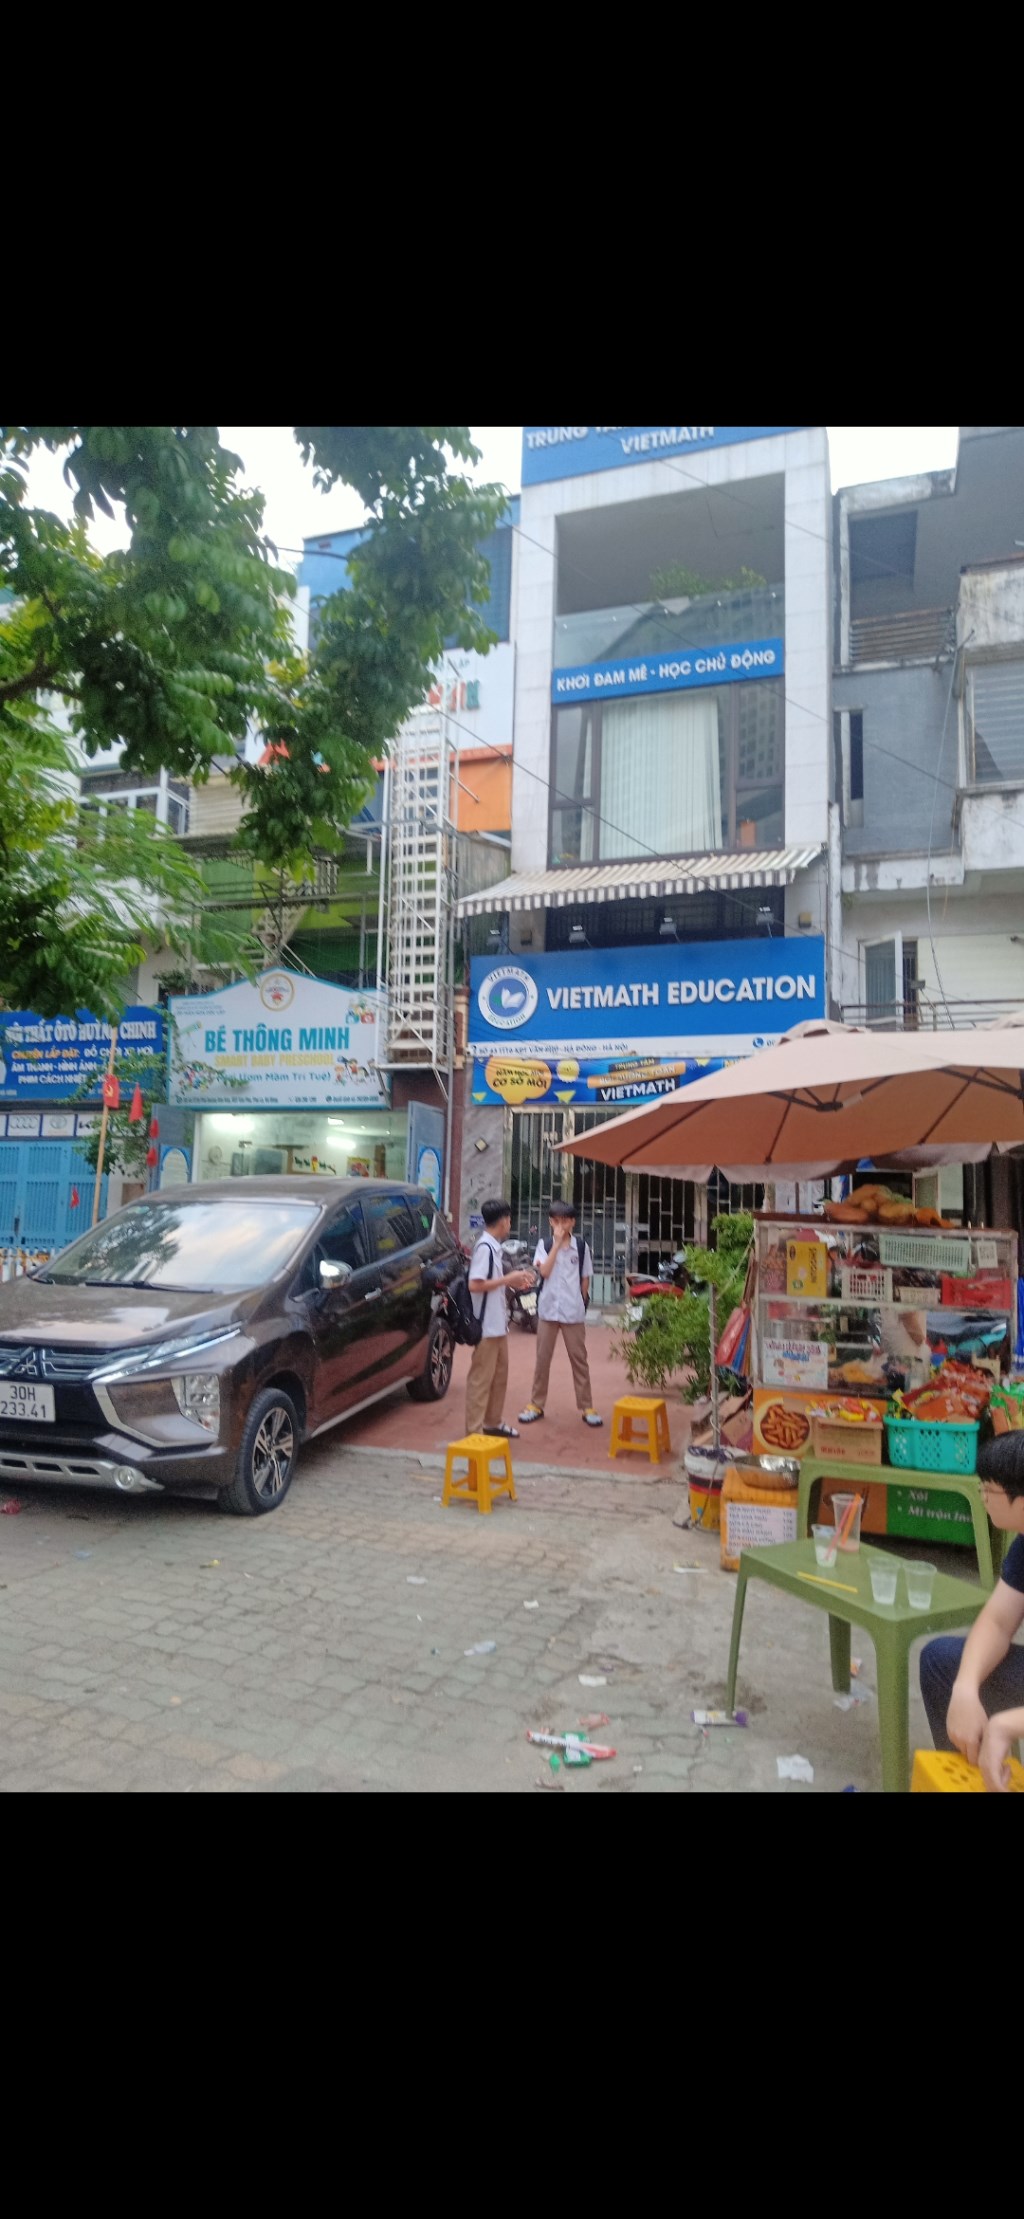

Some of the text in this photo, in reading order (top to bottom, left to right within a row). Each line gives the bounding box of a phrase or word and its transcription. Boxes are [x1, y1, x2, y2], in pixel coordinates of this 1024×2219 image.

[527, 427, 588, 449] TRUNG
[621, 427, 715, 454] VIETMATH
[594, 669, 625, 688] ĐAM
[629, 664, 648, 681] MÊ
[659, 662, 691, 679] HỌC
[695, 652, 725, 673] CHỦ
[731, 649, 775, 670] ĐỘNG
[546, 975, 816, 1009] VIETMATH EDUCATION
[205, 1022, 349, 1053] BÉ THÔNG MINH
[600, 1078, 676, 1102] VIETMATH
[10, 1385, 36, 1401] 30H
[1, 1401, 46, 1418] 233.41
